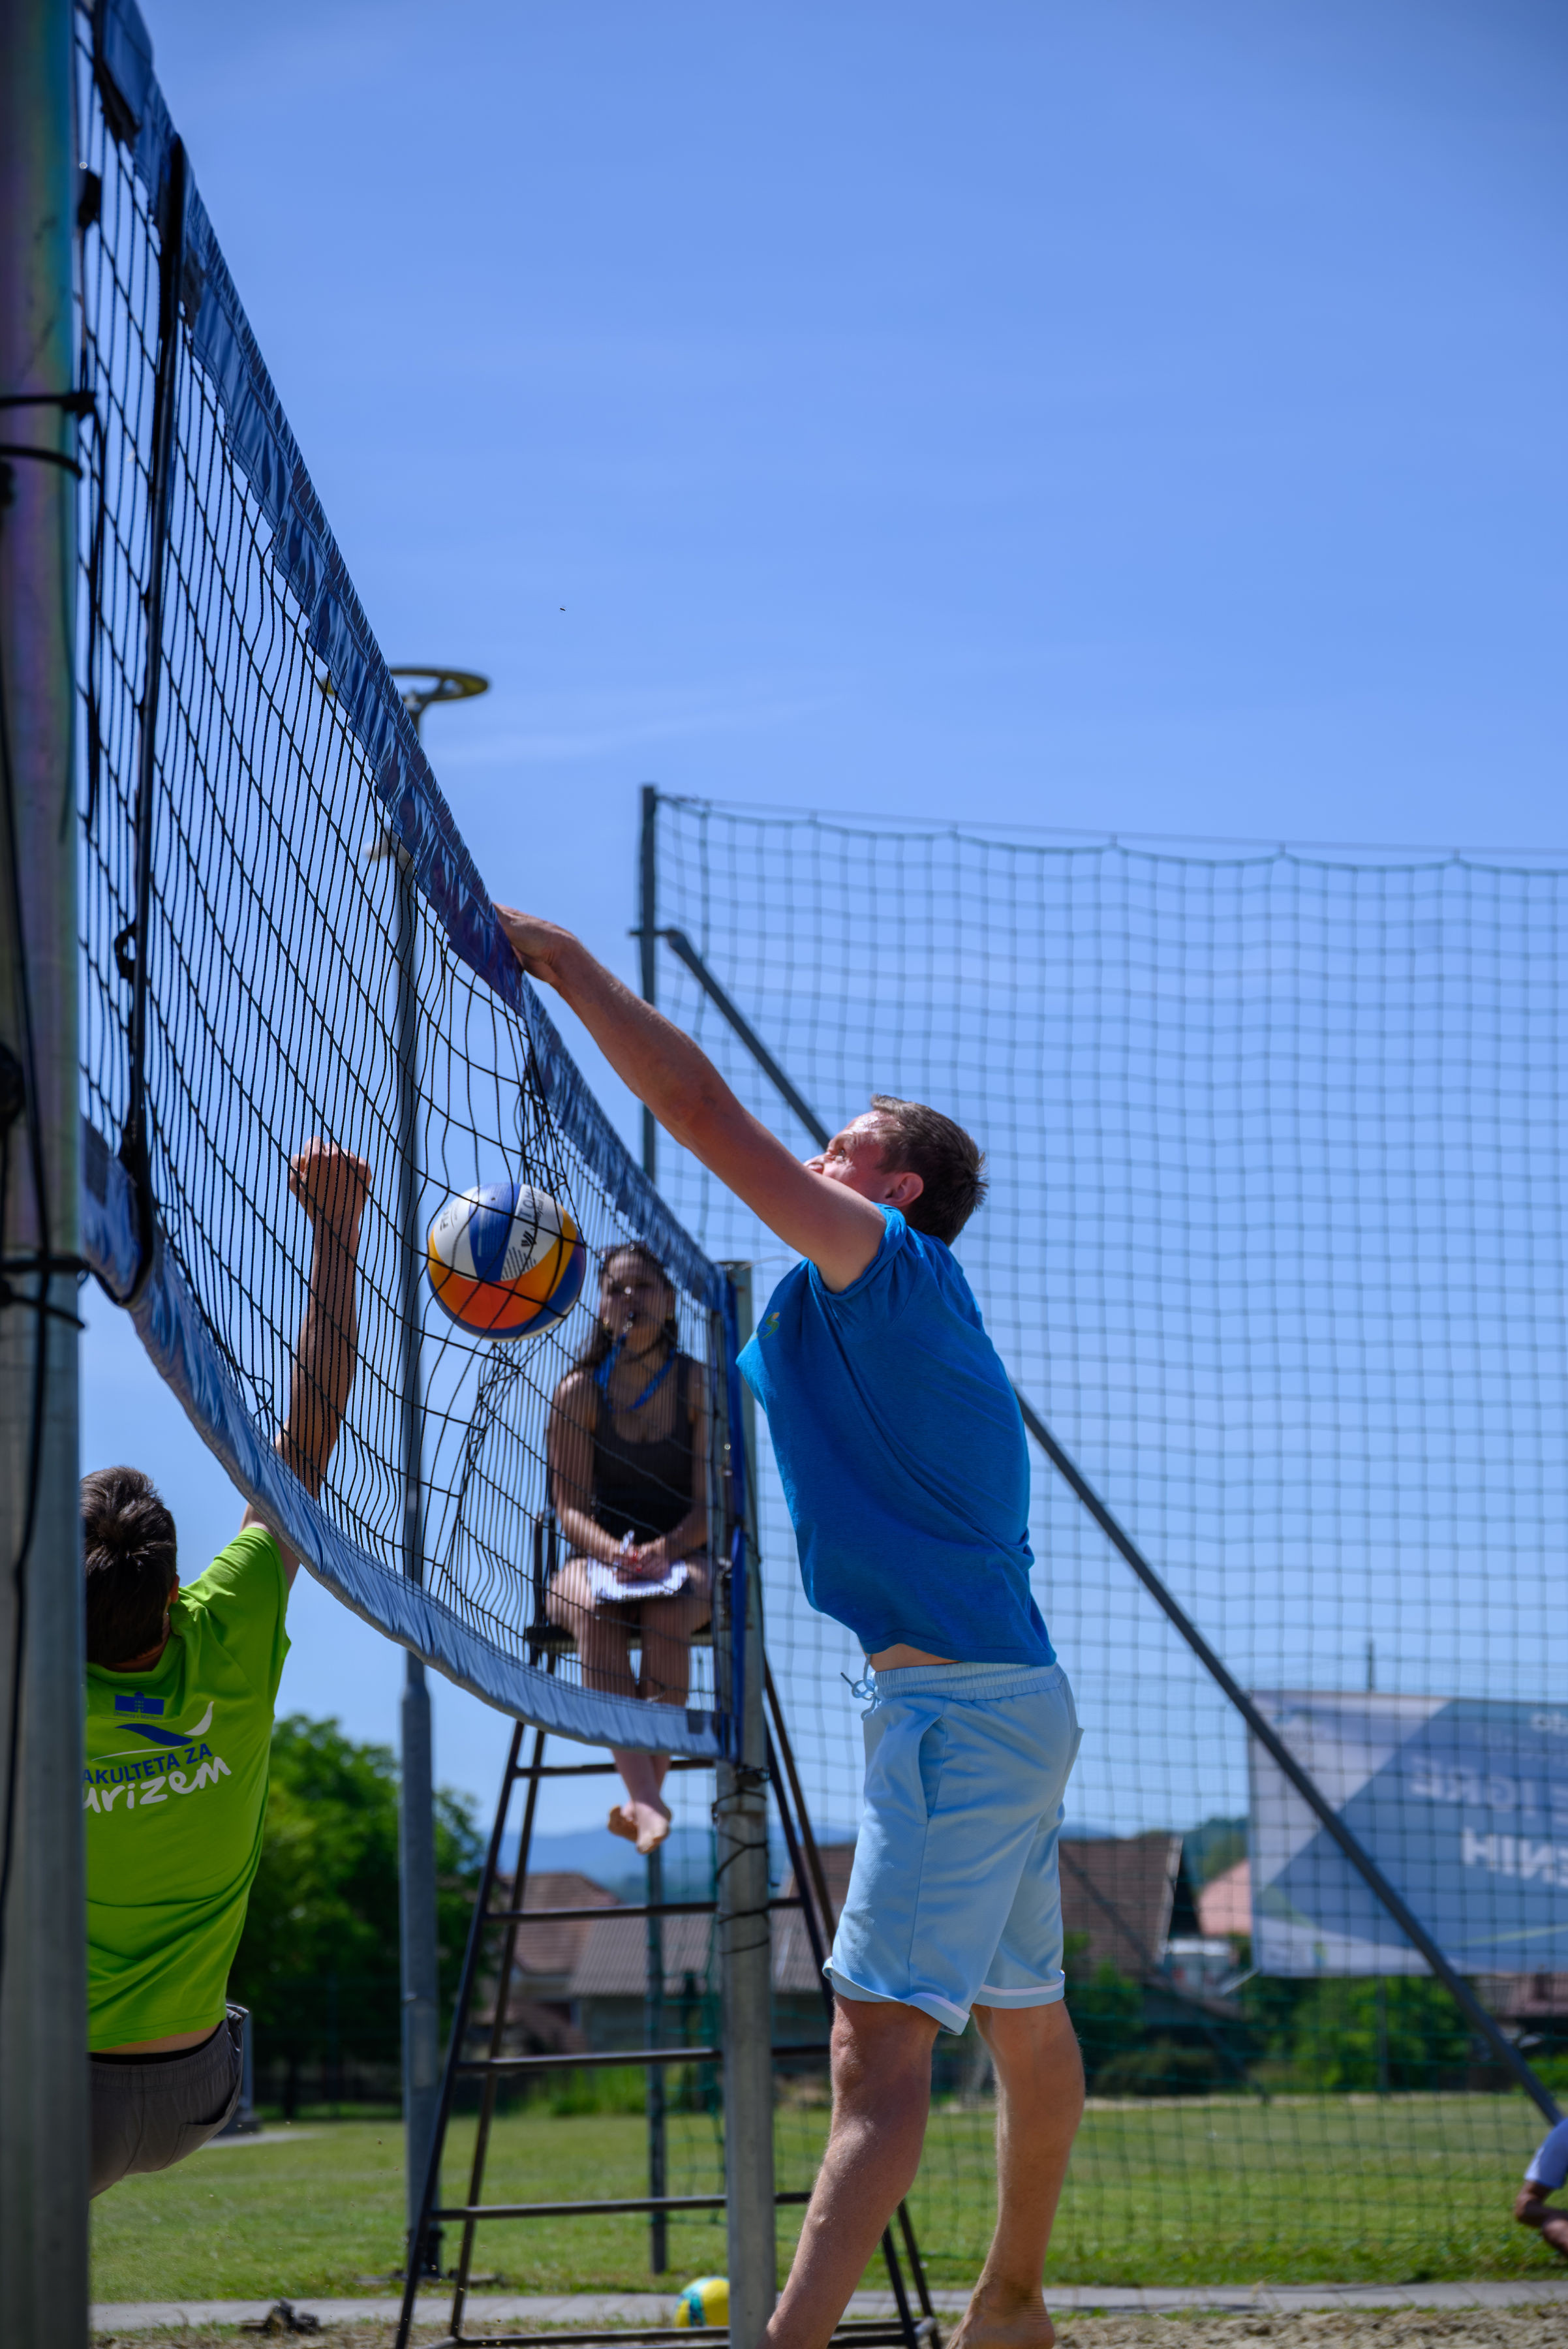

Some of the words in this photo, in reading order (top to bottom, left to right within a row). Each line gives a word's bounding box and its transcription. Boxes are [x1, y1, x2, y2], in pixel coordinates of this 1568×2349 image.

[82, 1753, 180, 1784] AKULTETA
[184, 1743, 213, 1764] ZA
[82, 1756, 232, 1813] urizem
